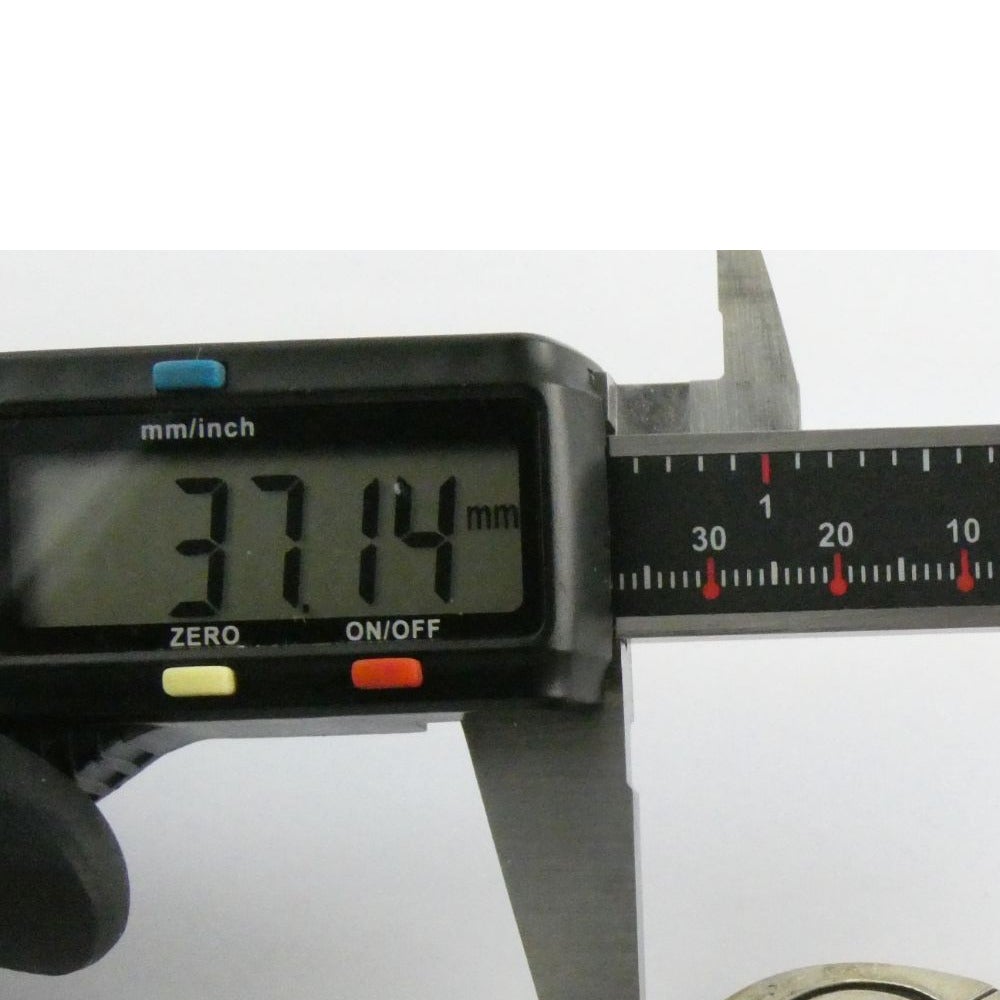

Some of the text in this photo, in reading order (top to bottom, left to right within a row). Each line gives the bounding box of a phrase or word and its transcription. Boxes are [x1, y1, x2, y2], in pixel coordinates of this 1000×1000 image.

[140, 417, 255, 441] mm/inch
[465, 502, 521, 532] mm
[759, 494, 772, 519] 1
[692, 525, 727, 552] 30
[818, 521, 854, 548] 20
[946, 517, 981, 544] 10
[169, 625, 241, 648] ZERO
[345, 618, 441, 642] ON/OFF
